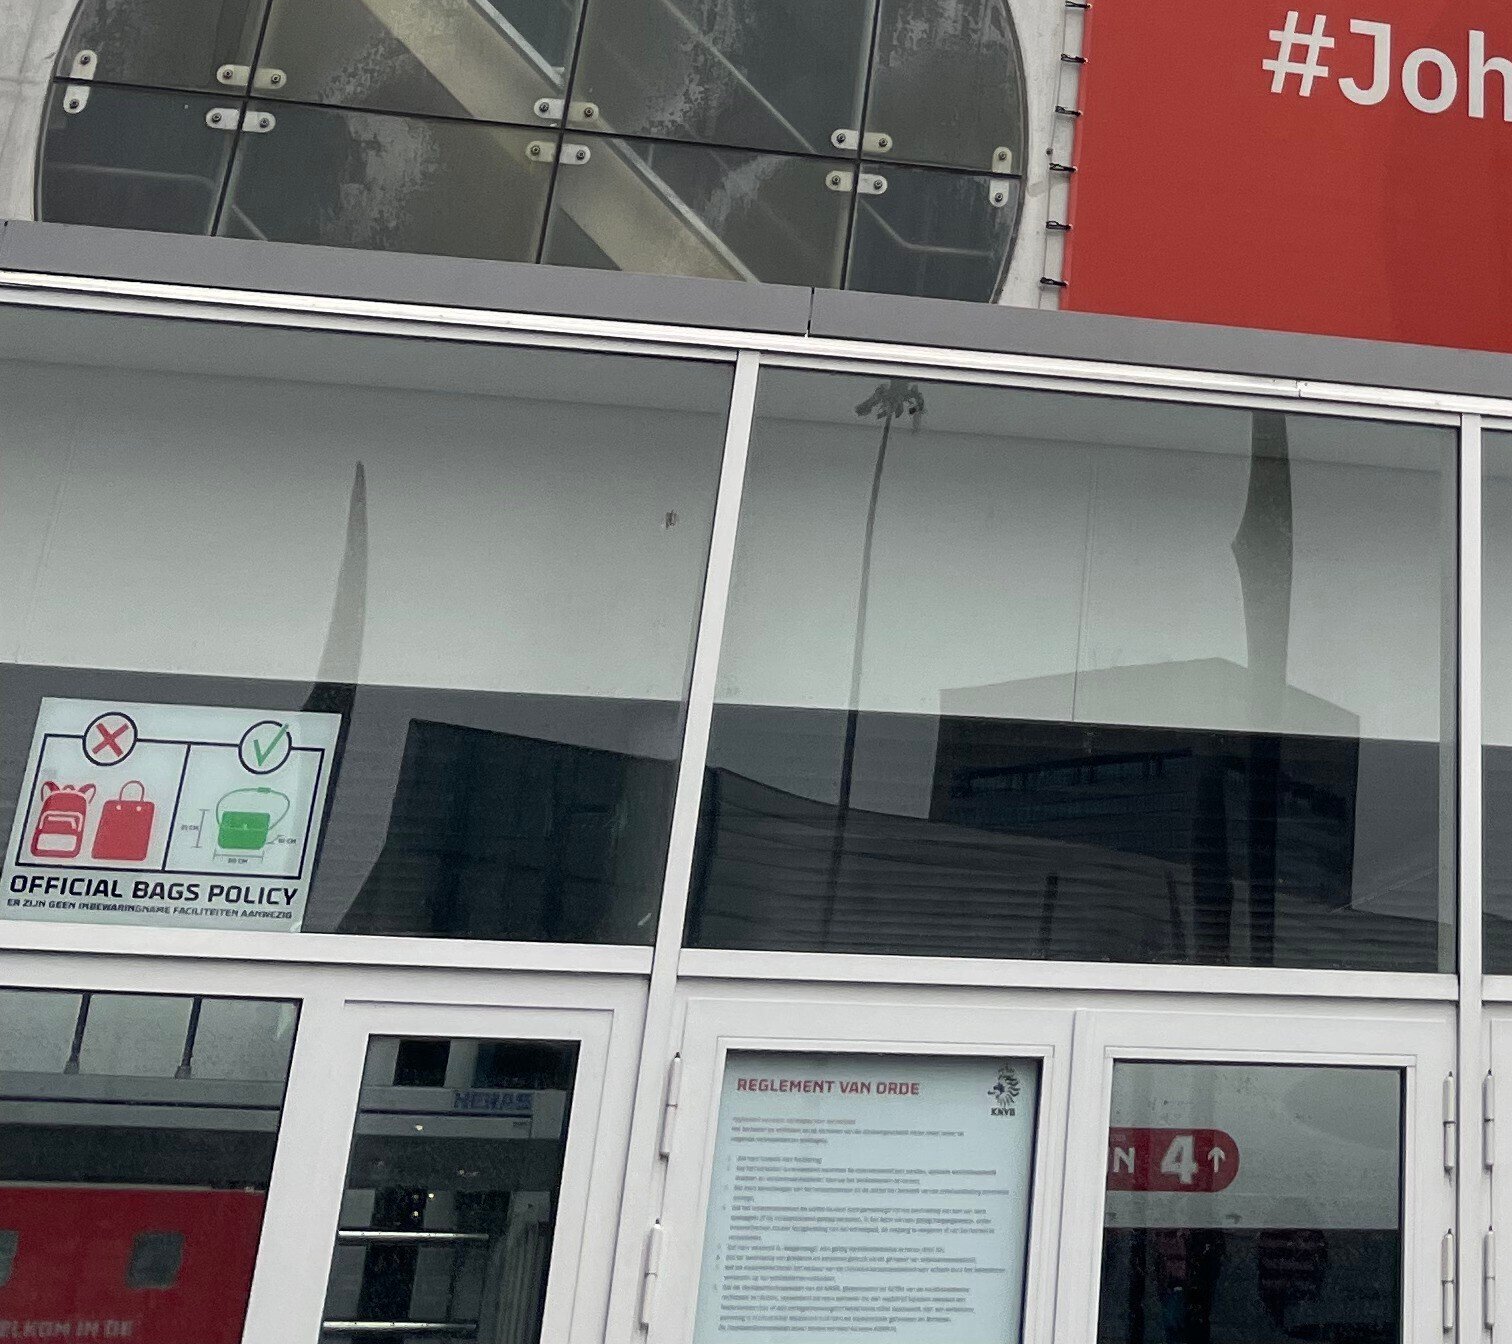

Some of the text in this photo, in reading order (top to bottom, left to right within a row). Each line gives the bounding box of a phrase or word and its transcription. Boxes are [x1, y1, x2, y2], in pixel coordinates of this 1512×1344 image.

[10, 874, 299, 906] OFFICIAL BAGS POLICY
[737, 1077, 920, 1095] REGLEMENT VAN ORDE
[990, 1107, 1016, 1117] KNVB
[1160, 1134, 1199, 1185] 4
